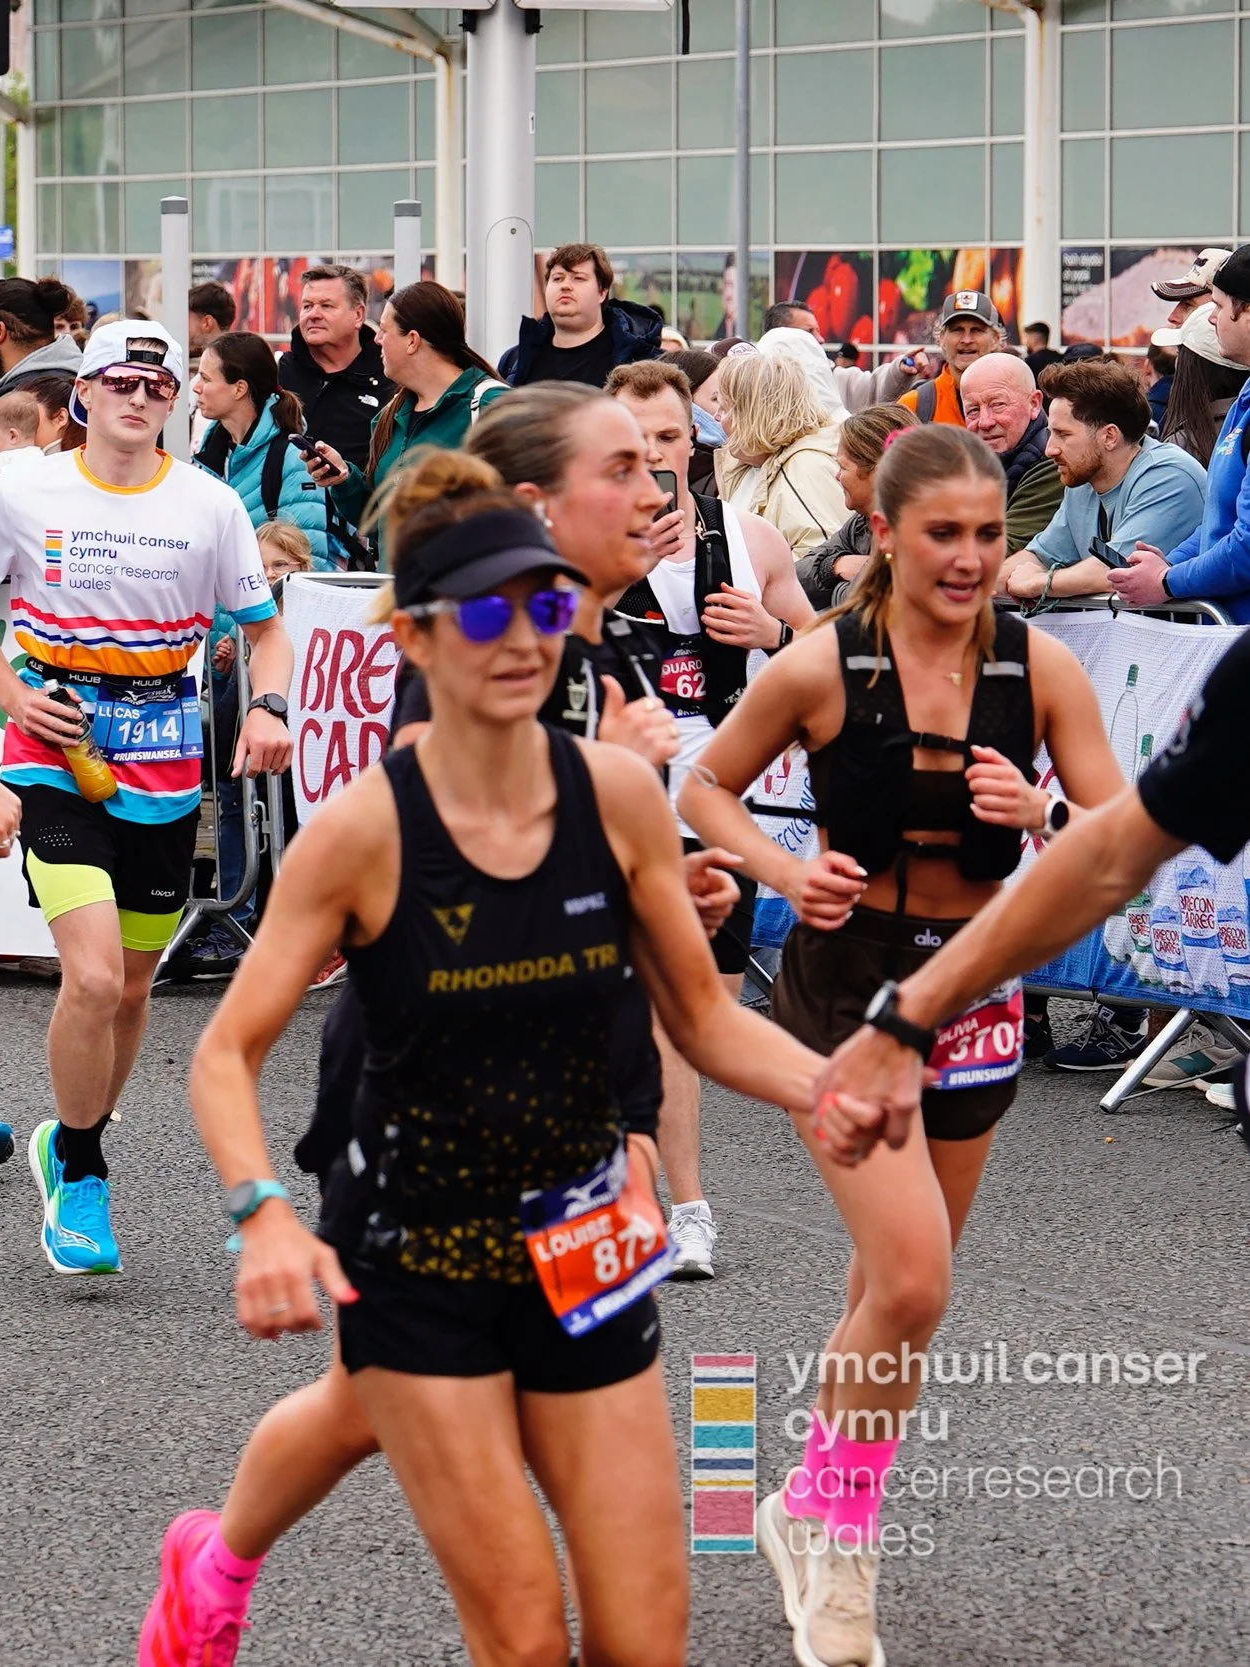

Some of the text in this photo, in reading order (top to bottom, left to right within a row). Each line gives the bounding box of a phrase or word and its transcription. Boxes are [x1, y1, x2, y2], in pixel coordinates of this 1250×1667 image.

[71, 529, 190, 551] ymchwil canser
[69, 546, 118, 559] cymru
[68, 561, 180, 581] cancer research
[69, 577, 112, 590] wales
[68, 673, 101, 684] HUUB
[301, 627, 400, 718] BRE
[132, 679, 162, 687] HUUB
[98, 705, 141, 720] LUCAS
[118, 716, 180, 745] 1914
[112, 749, 182, 762] #RUNSWANSEA
[914, 927, 942, 947] alo
[429, 953, 577, 993] RHONDDA
[535, 1213, 615, 1264] LOUISE
